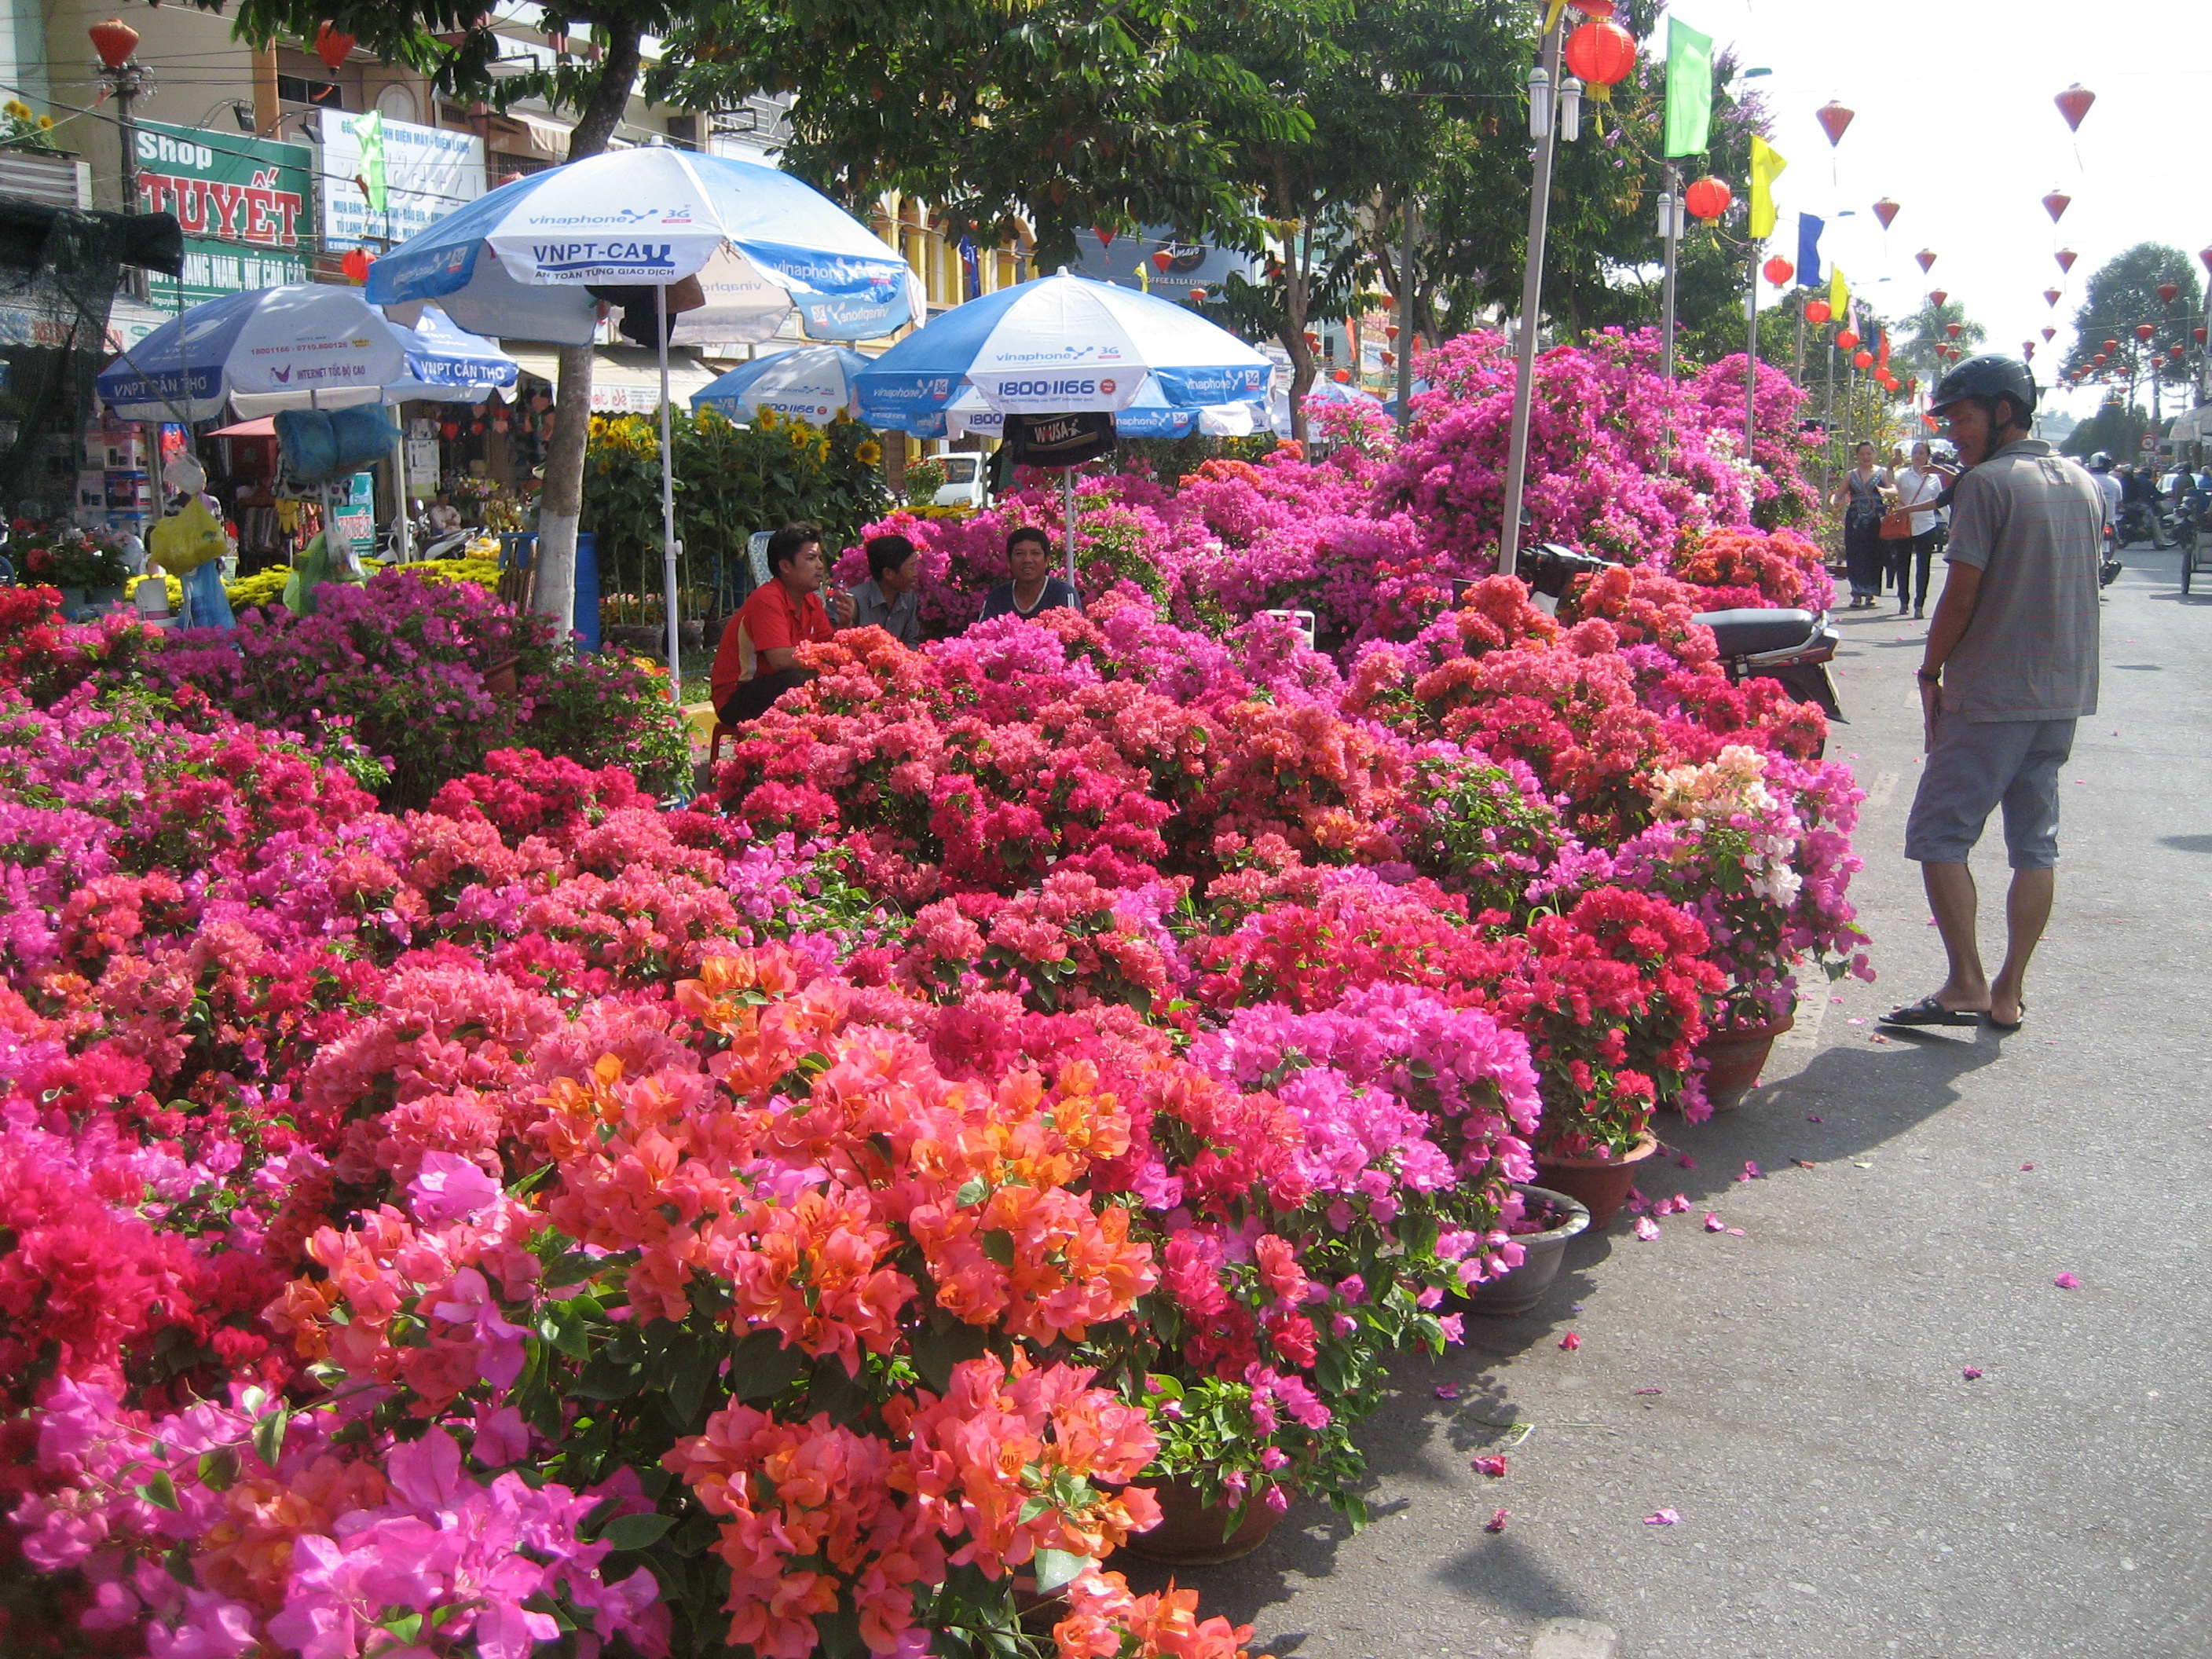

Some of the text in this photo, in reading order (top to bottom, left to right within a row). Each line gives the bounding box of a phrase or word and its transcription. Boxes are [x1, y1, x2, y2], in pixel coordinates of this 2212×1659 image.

[137, 130, 213, 170] Shop
[140, 167, 303, 246] TUYẾT
[529, 210, 690, 225] vinaphone 3G
[533, 244, 640, 262] VNPT-CA
[996, 352, 1071, 362] vinaphone
[297, 367, 327, 380] INTERNET
[353, 365, 366, 376] CAO
[421, 361, 451, 375] VNPT
[1185, 372, 1259, 391] vinaphone 3G
[114, 382, 147, 397] VNPT
[873, 386, 920, 399] vinaphone
[969, 412, 1003, 426] 1800
[1116, 416, 1159, 427] naphone
